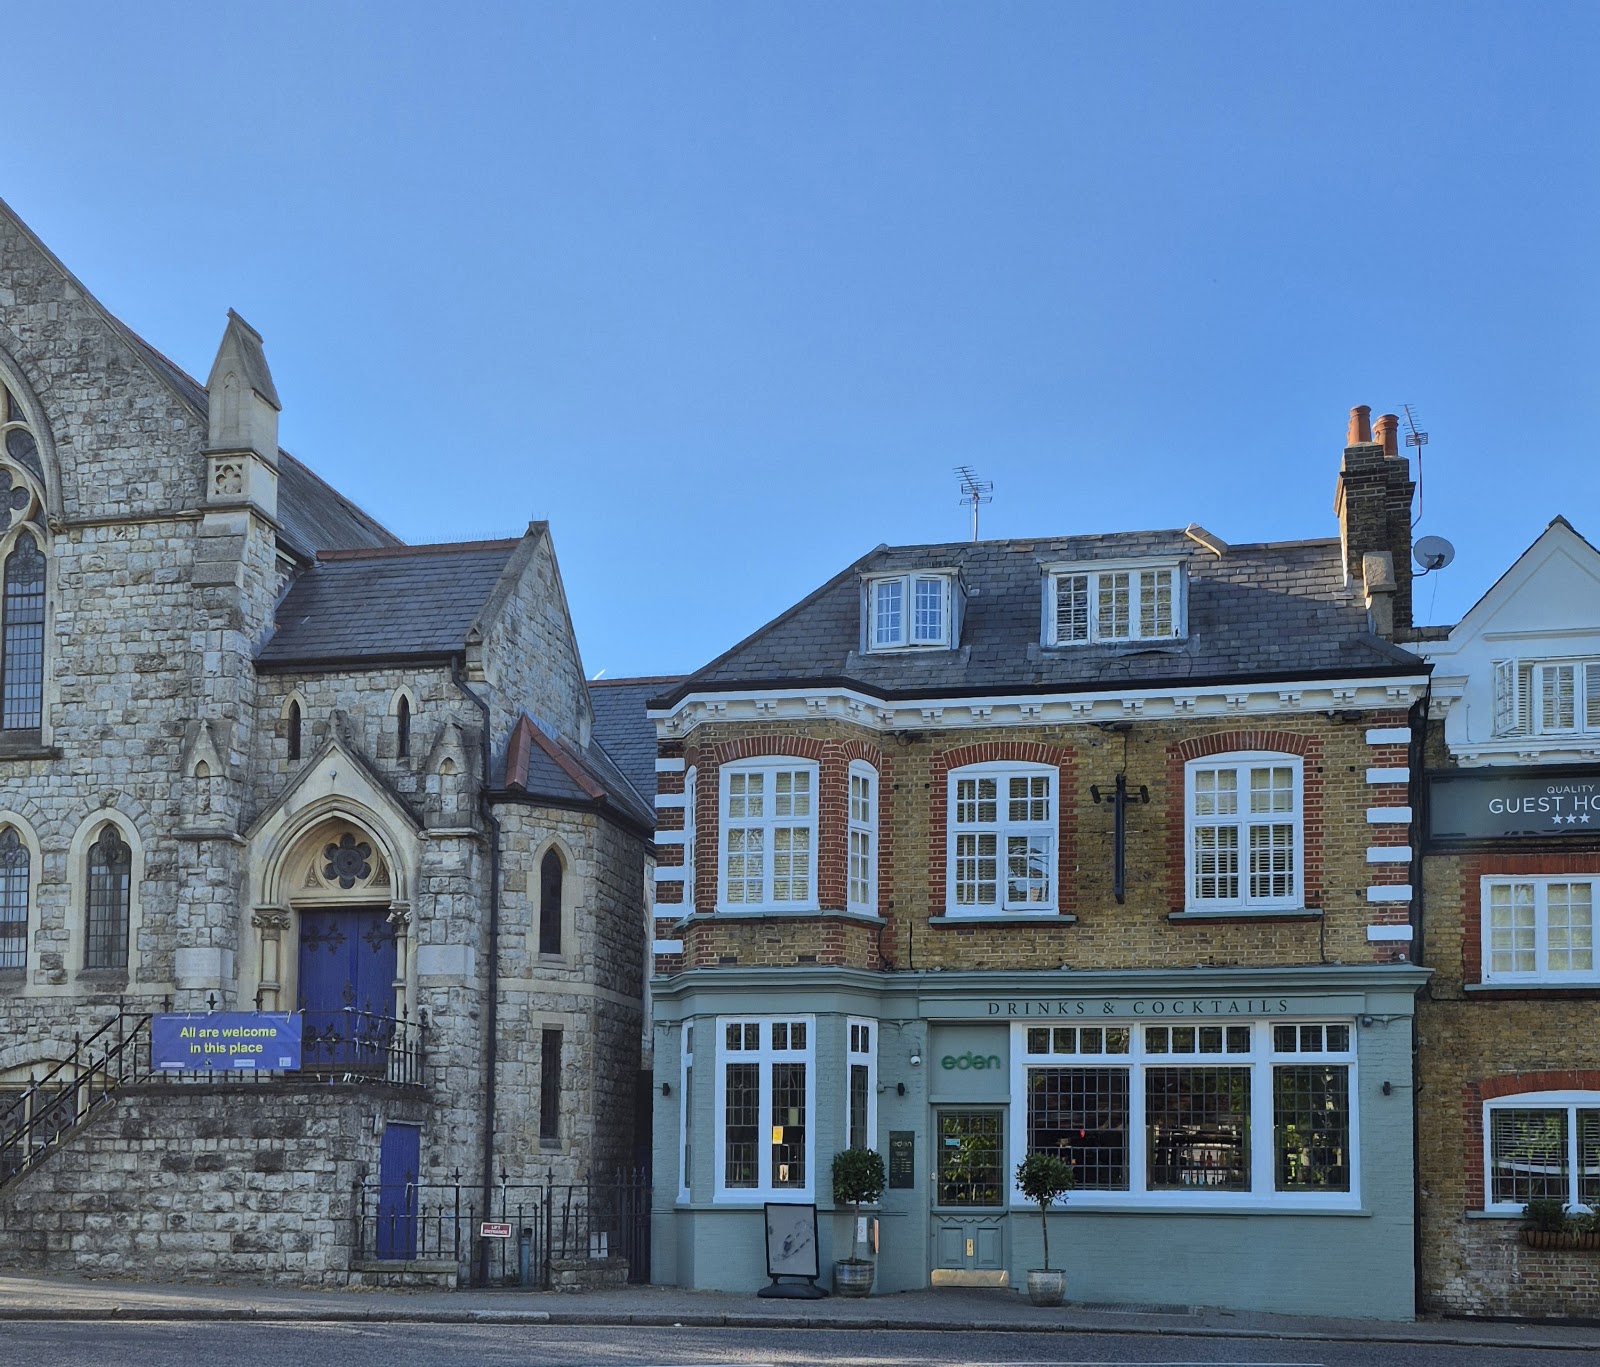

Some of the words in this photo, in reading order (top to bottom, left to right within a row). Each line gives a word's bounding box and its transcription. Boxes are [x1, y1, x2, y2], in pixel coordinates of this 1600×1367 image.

[1546, 784, 1595, 794] QUALITY
[1488, 796, 1565, 814] GUEST
[988, 1001, 1085, 1015] DRINKS
[1102, 1001, 1115, 1014] &
[1133, 999, 1288, 1014] COCKTAILS
[180, 1026, 196, 1038] All
[199, 1028, 219, 1038] are
[222, 1026, 277, 1038] welcome
[190, 1043, 201, 1054] in
[204, 1042, 227, 1054] this
[229, 1041, 264, 1055] place
[941, 1051, 1001, 1071] eden
